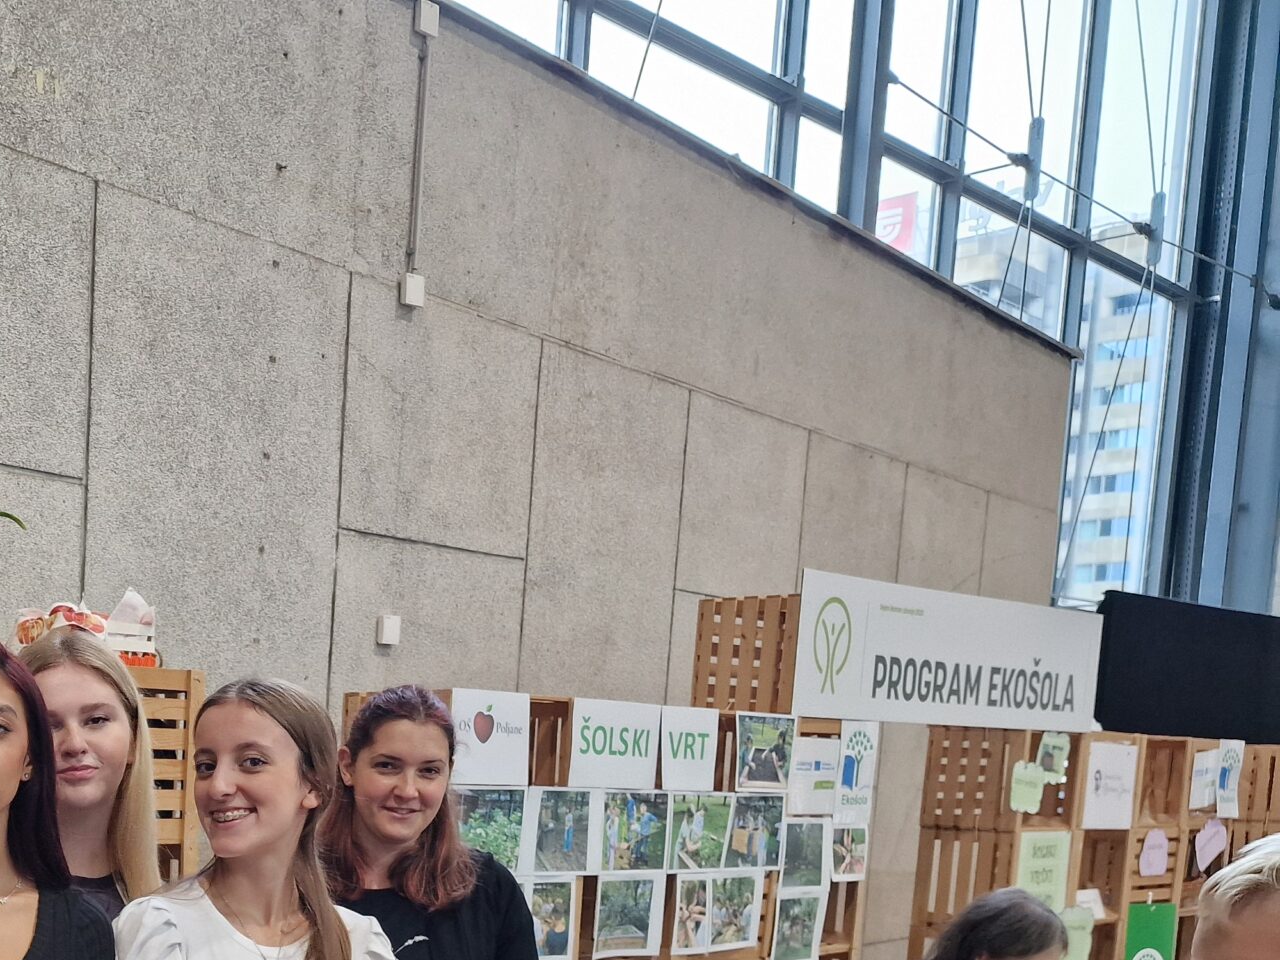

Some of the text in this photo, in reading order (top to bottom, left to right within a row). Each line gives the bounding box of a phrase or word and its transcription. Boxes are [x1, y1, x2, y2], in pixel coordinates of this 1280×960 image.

[871, 654, 1075, 712] PROGRAM EKOŠOLA
[458, 718, 523, 737] OŠ Poljane
[579, 716, 710, 761] ŠOLSKI VRT
